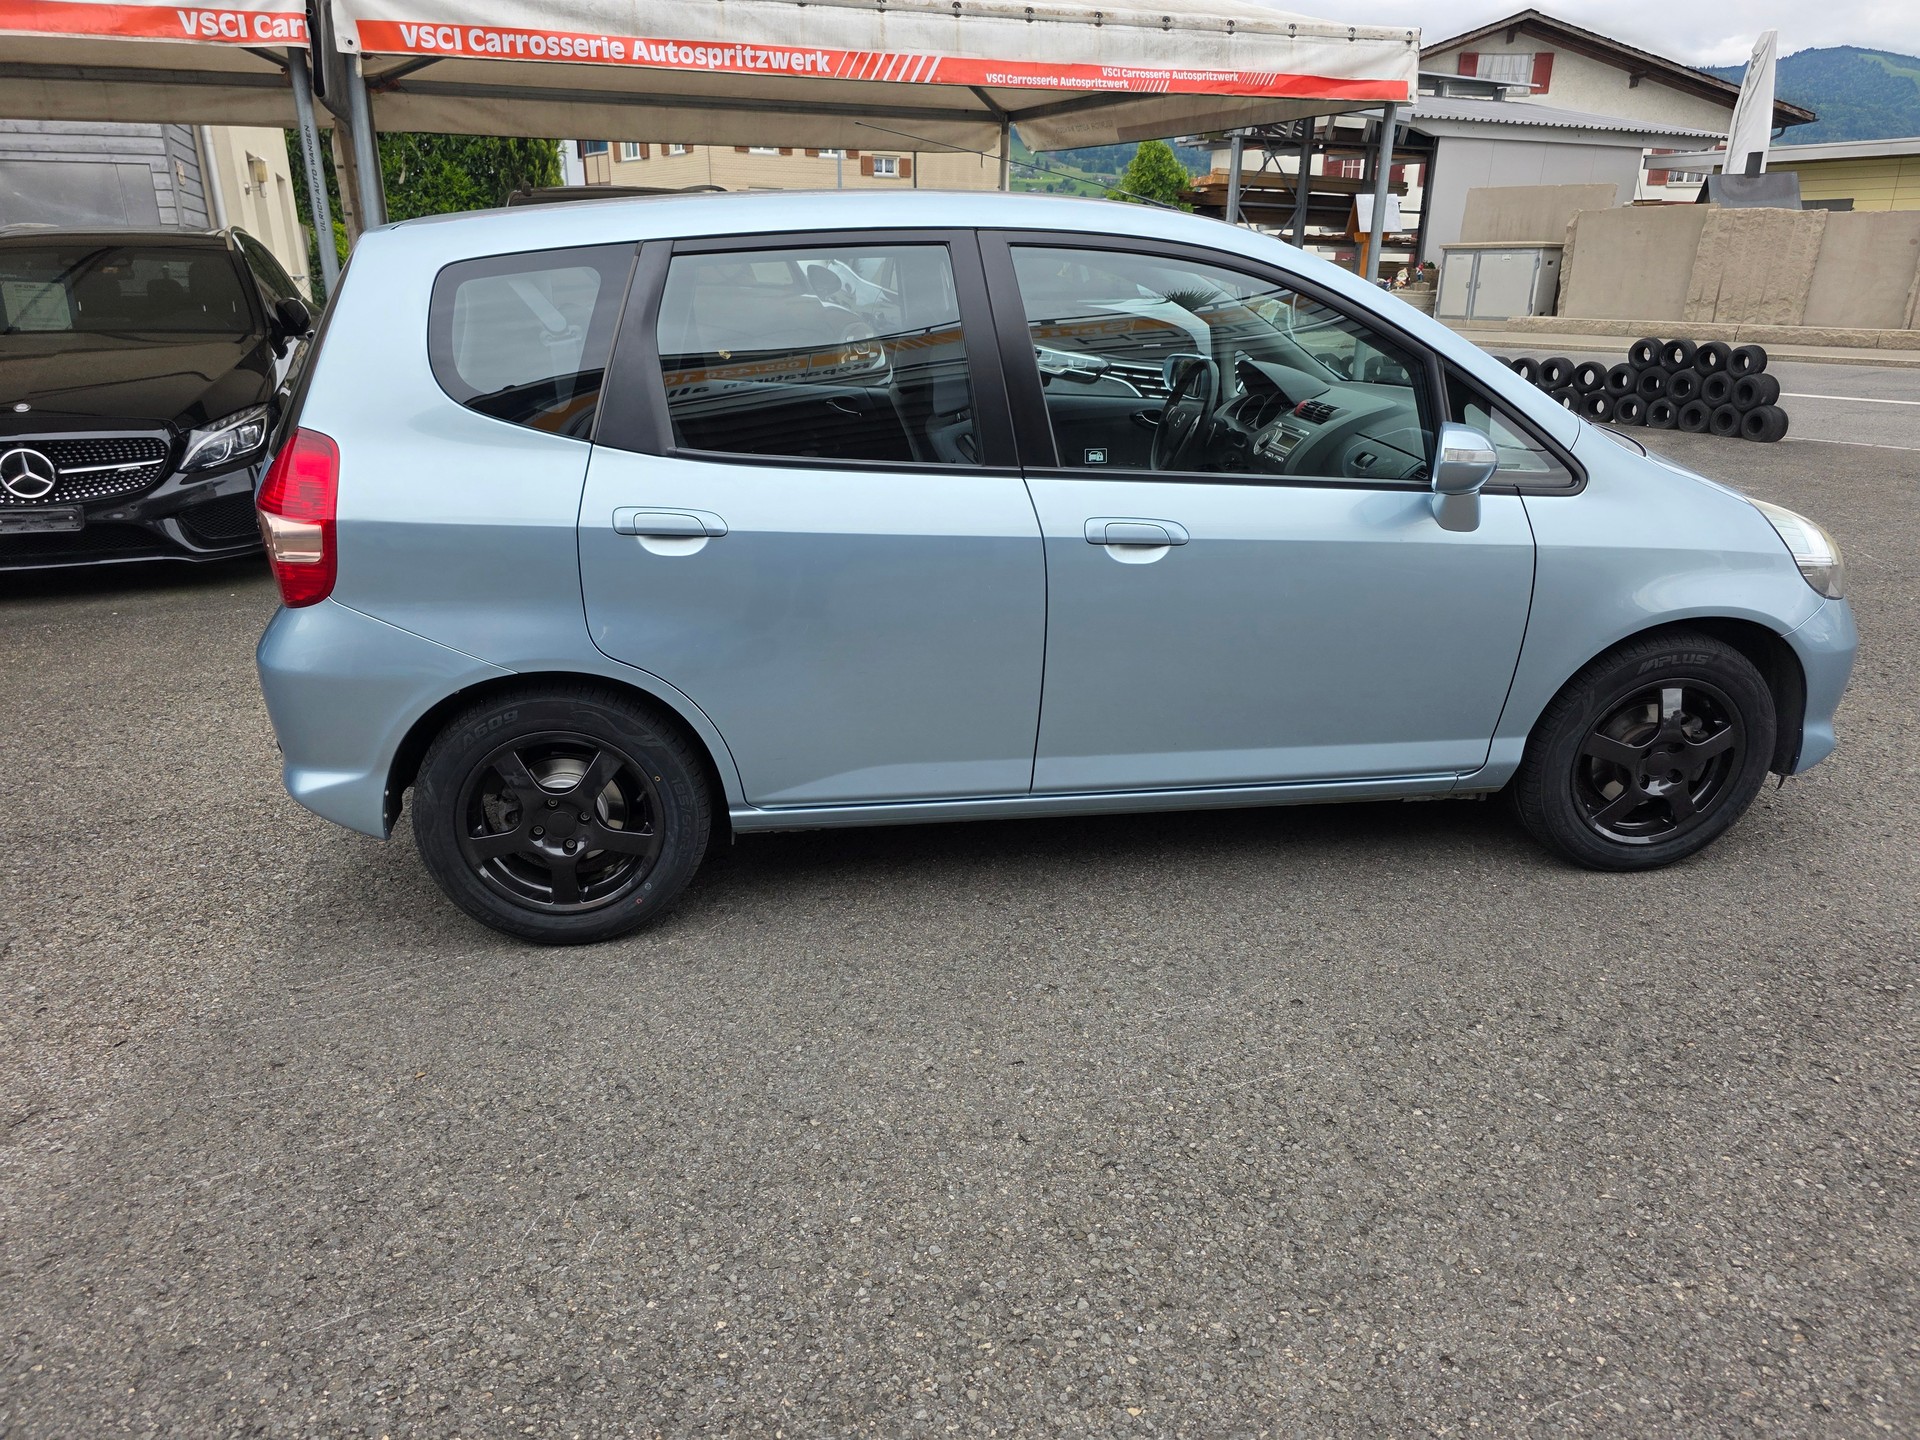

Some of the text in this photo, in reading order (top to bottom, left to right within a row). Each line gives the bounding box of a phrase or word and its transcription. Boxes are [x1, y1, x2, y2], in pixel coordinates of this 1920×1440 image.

[177, 10, 248, 38] VSCI
[399, 24, 831, 73] VSCI Carrosserie Autospritzwerk
[986, 73, 1129, 89] VSCI Carrosserie Autospritzwerk
[1102, 67, 1239, 82] VSCI Carrosserie Autospritzwerk
[304, 125, 327, 232] ULRICH AUTO WANGEN
[463, 709, 519, 750] A609
